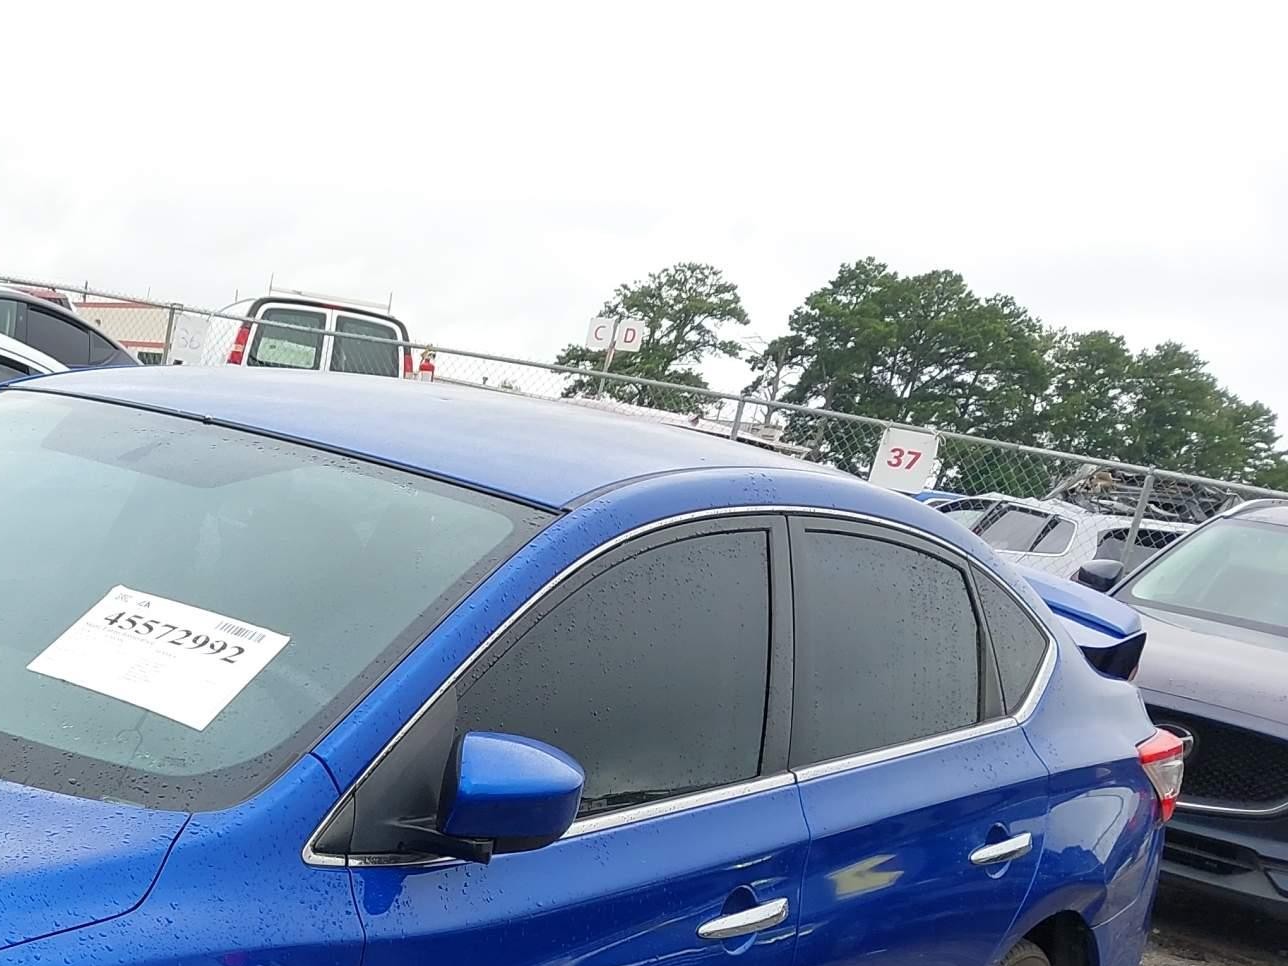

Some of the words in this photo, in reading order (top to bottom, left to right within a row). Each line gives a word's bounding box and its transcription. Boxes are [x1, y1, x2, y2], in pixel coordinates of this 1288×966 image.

[594, 325, 606, 341] C
[623, 327, 636, 343] D
[887, 447, 922, 470] 37
[103, 610, 247, 665] 45572992
